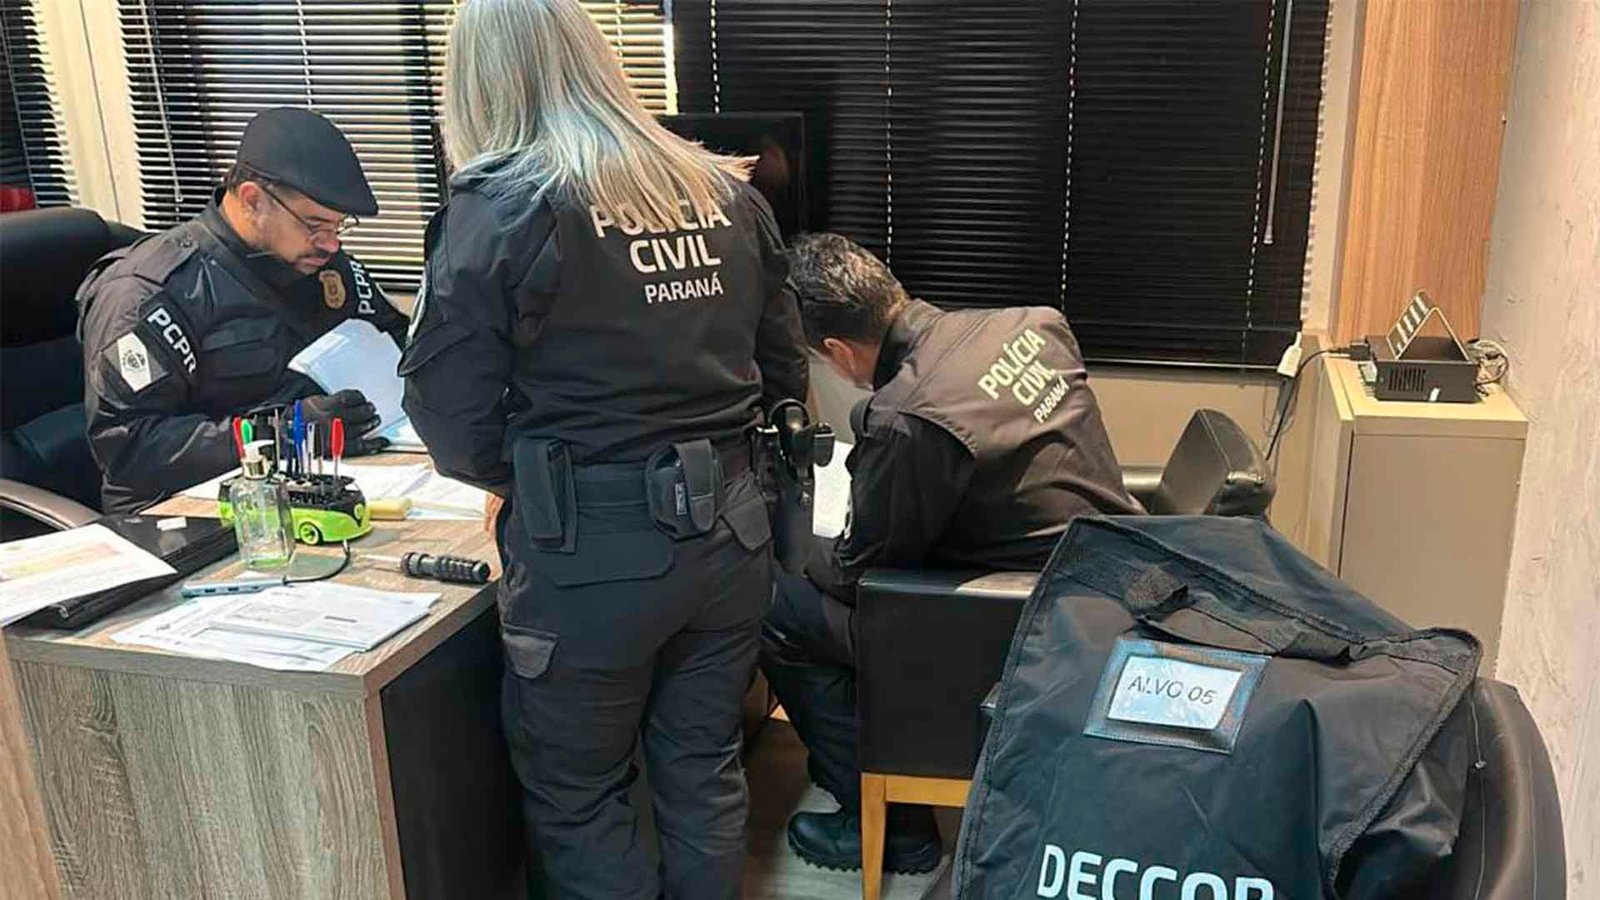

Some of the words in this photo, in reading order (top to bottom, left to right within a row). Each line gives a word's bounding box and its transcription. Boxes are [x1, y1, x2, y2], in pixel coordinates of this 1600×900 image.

[589, 199, 732, 238] POCIA
[630, 235, 722, 273] CIVIL
[350, 260, 376, 314] PCPR
[645, 271, 724, 304] PARANÁ
[147, 307, 197, 374] PCPR
[977, 329, 1046, 400] POLÍCIA
[1012, 360, 1056, 405] CIVIL
[1188, 686, 1217, 705] 05
